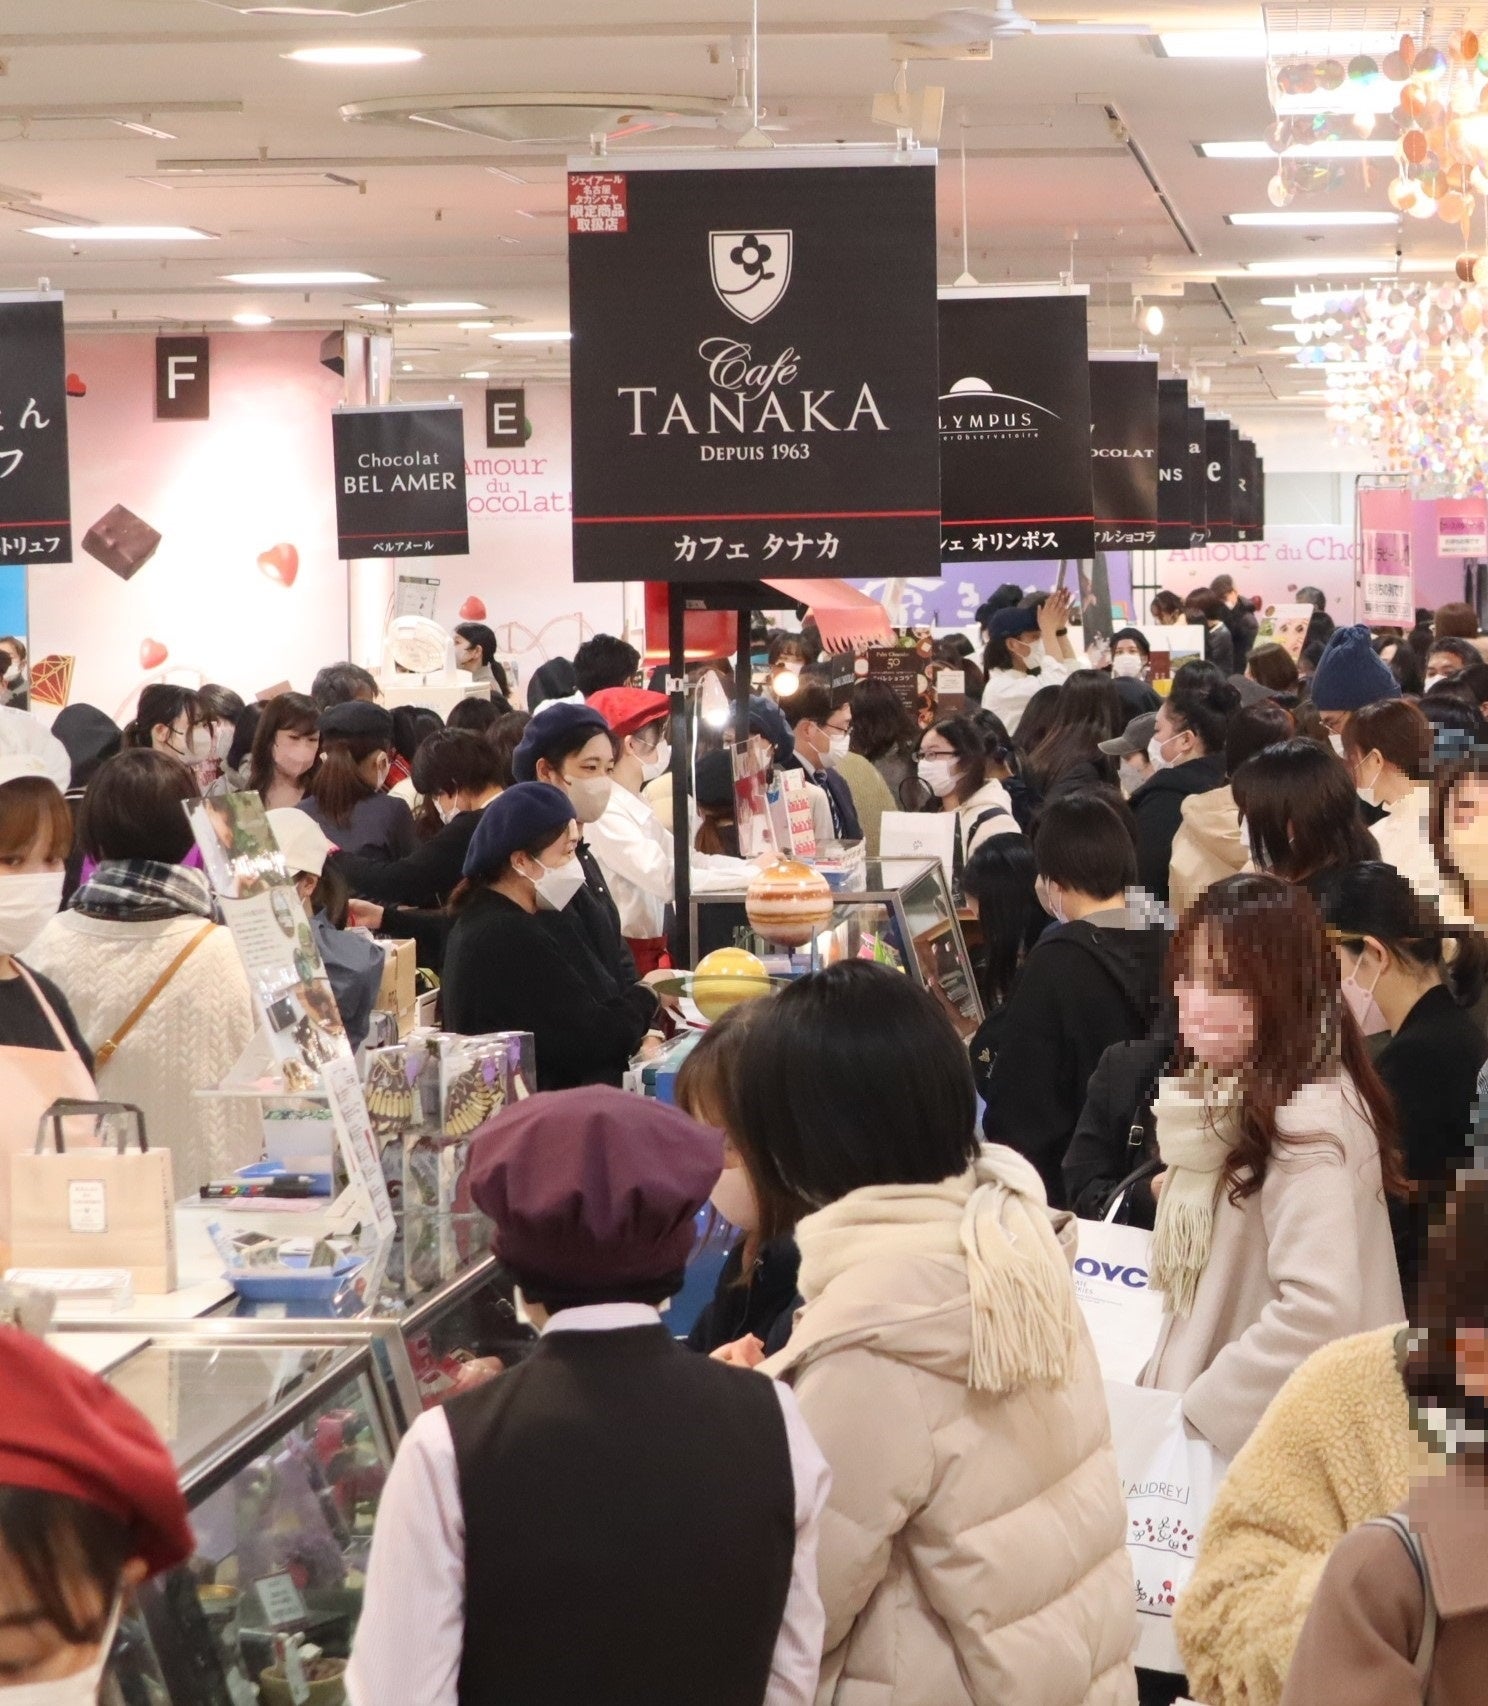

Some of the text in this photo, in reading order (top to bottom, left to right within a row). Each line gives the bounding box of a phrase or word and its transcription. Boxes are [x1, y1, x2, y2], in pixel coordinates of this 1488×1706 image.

[168, 356, 198, 399] F
[699, 337, 801, 402] Café
[494, 403, 518, 434] E
[617, 382, 890, 436] TANAKA
[938, 412, 1033, 430] LYMPUS
[943, 432, 1039, 442] erObservatoire
[358, 451, 440, 468] Chocolat
[771, 443, 811, 460] 1963
[344, 472, 457, 494] BEL AMER
[487, 478, 511, 493] du
[373, 540, 434, 552] ベルアメール
[674, 531, 840, 562] カフェ タナカ
[971, 531, 1059, 552] オリンポス
[1277, 543, 1302, 561] du
[1306, 536, 1362, 561] Cho
[1074, 1257, 1149, 1288] OYC
[1129, 1482, 1183, 1498] AUDREY
